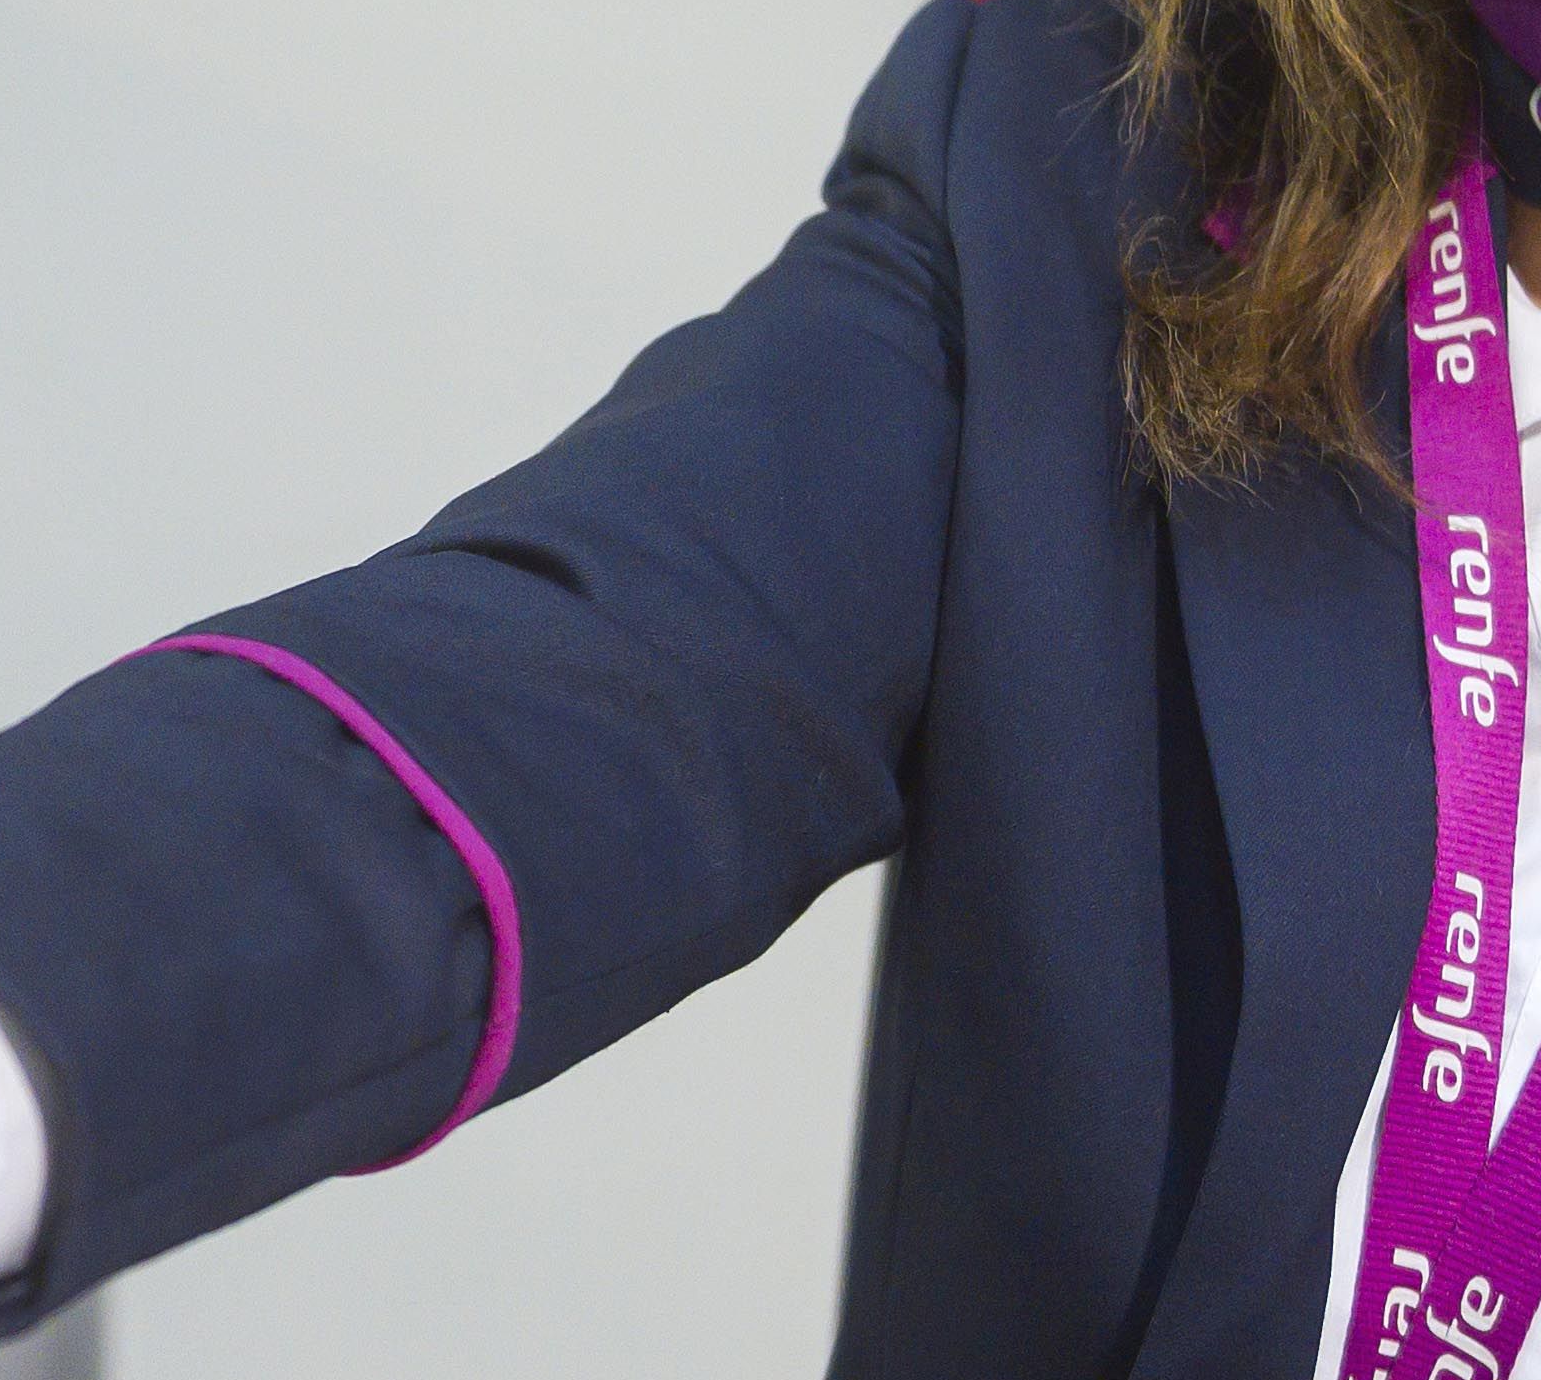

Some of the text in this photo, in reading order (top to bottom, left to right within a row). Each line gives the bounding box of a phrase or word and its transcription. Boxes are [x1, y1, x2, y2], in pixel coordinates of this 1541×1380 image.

[1412, 200, 1497, 385] renfe
[1432, 515, 1519, 728] renfe
[1413, 870, 1490, 1104] renfe
